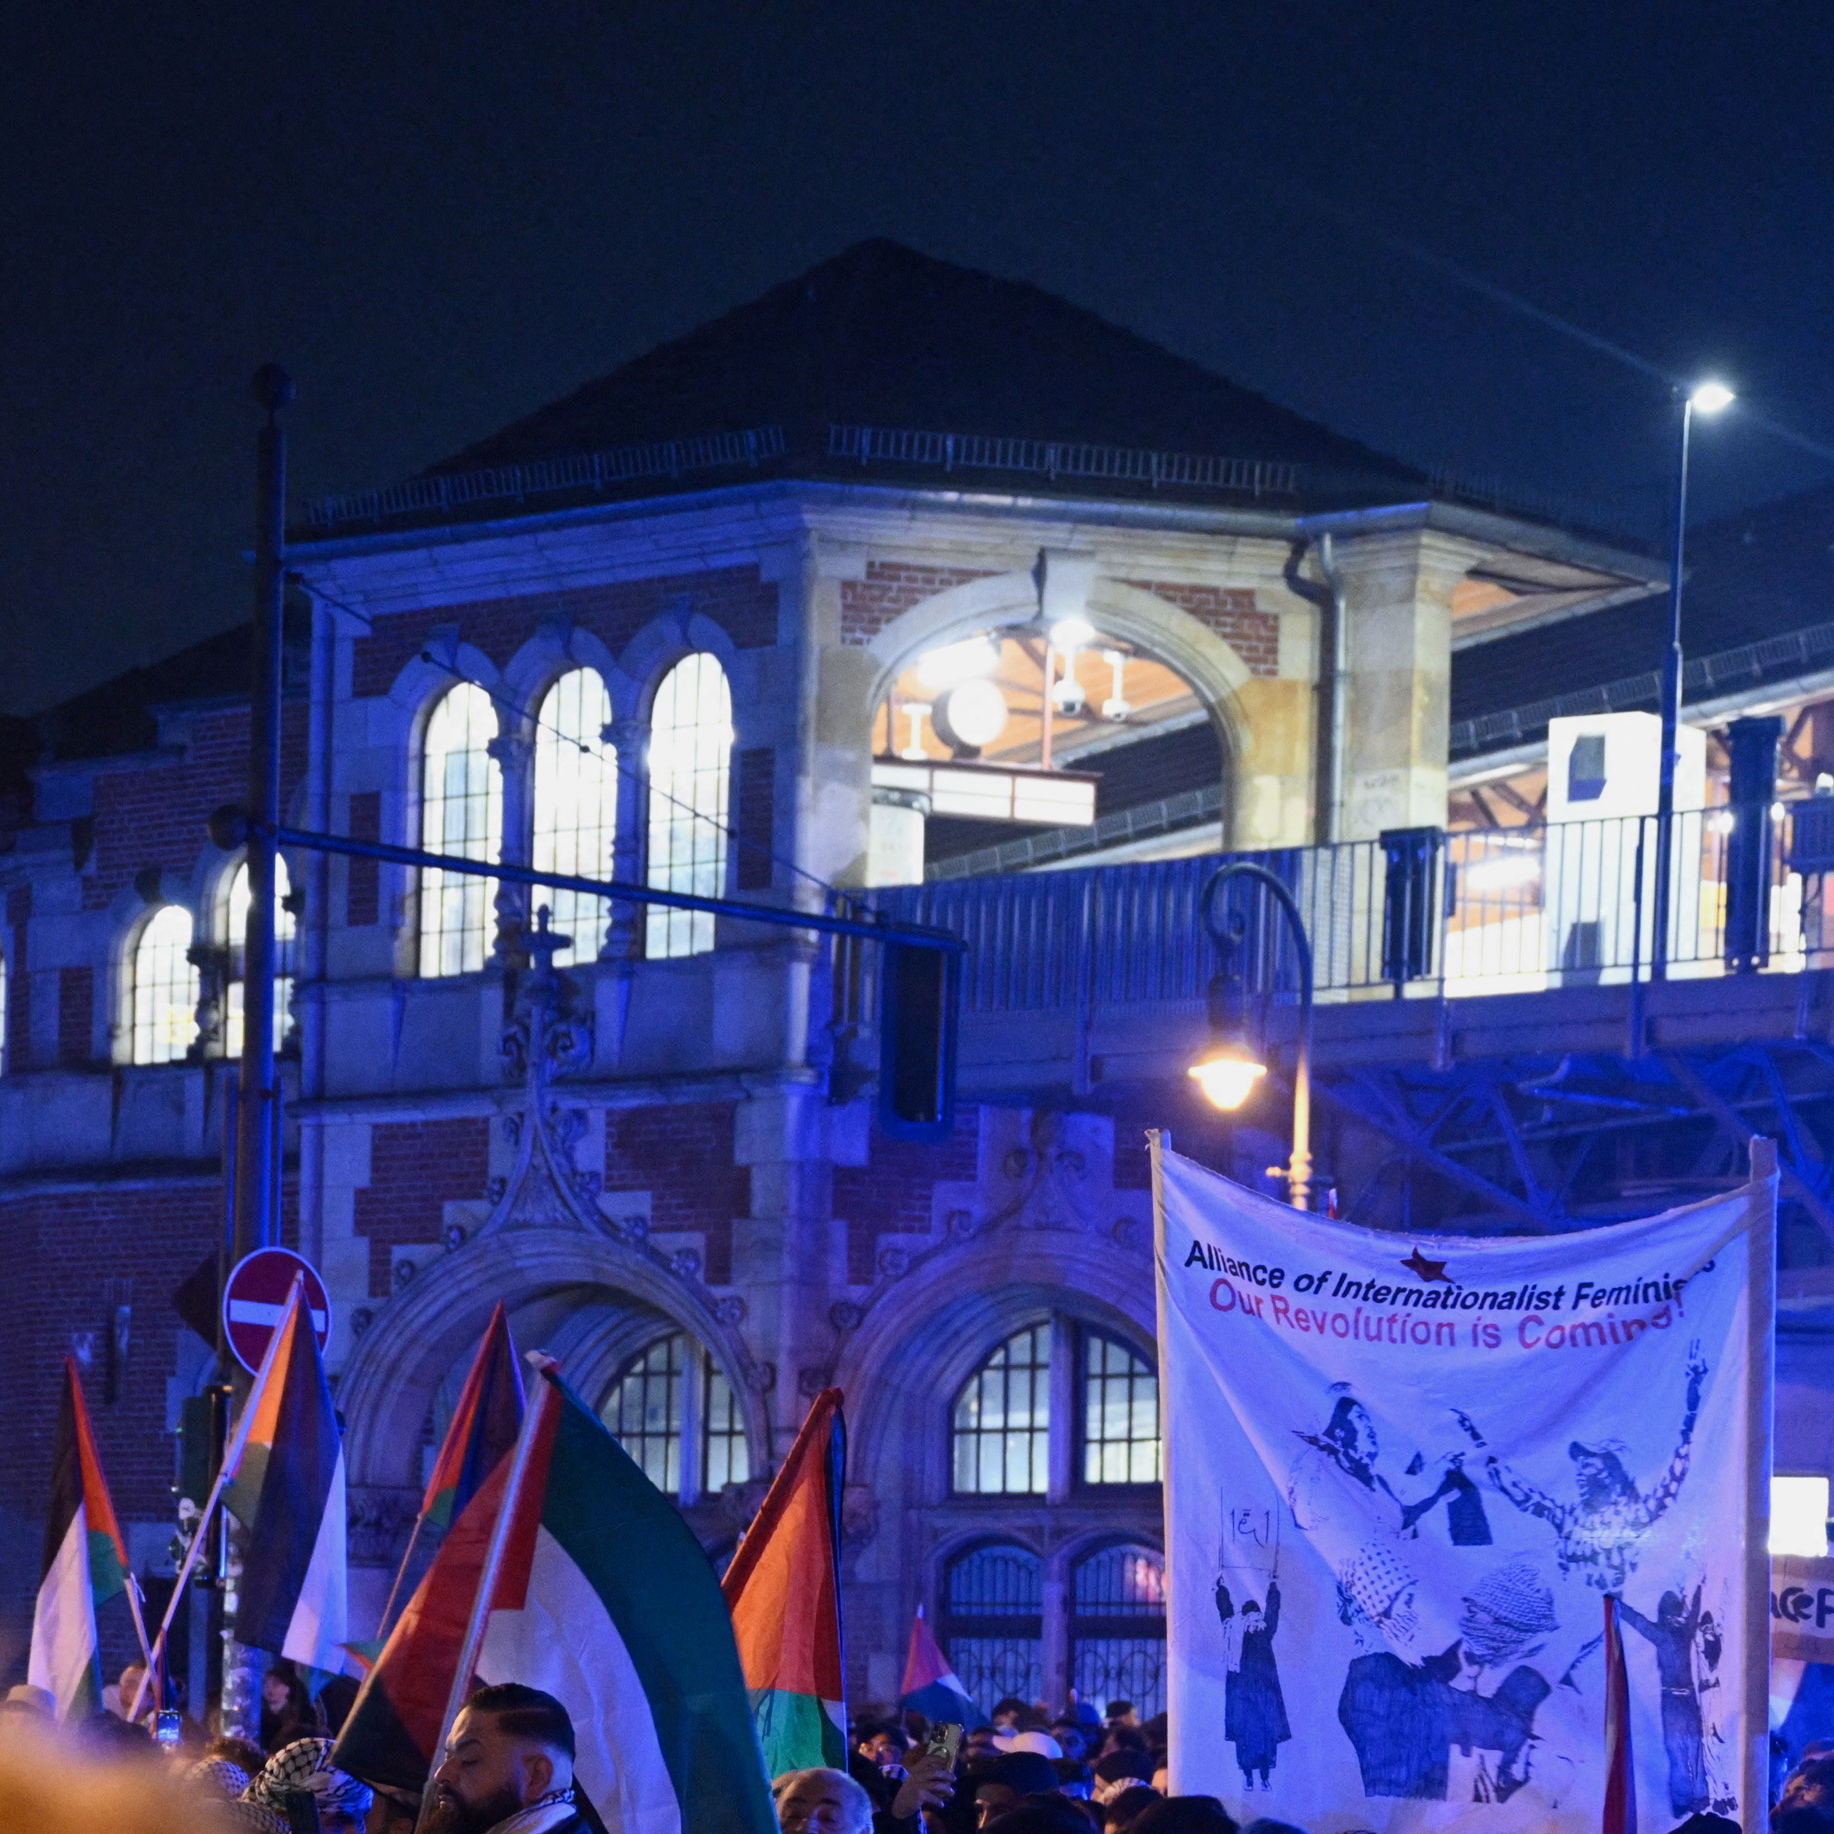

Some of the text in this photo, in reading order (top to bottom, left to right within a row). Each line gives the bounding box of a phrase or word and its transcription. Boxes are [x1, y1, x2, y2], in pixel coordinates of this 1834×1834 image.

[1184, 1240, 1285, 1289] Alliance
[1293, 1270, 1332, 1296] of
[1332, 1272, 1566, 1311] Internationalist
[1209, 1278, 1264, 1319] Our
[1270, 1293, 1456, 1347] Revolution
[1472, 1315, 1501, 1349] is
